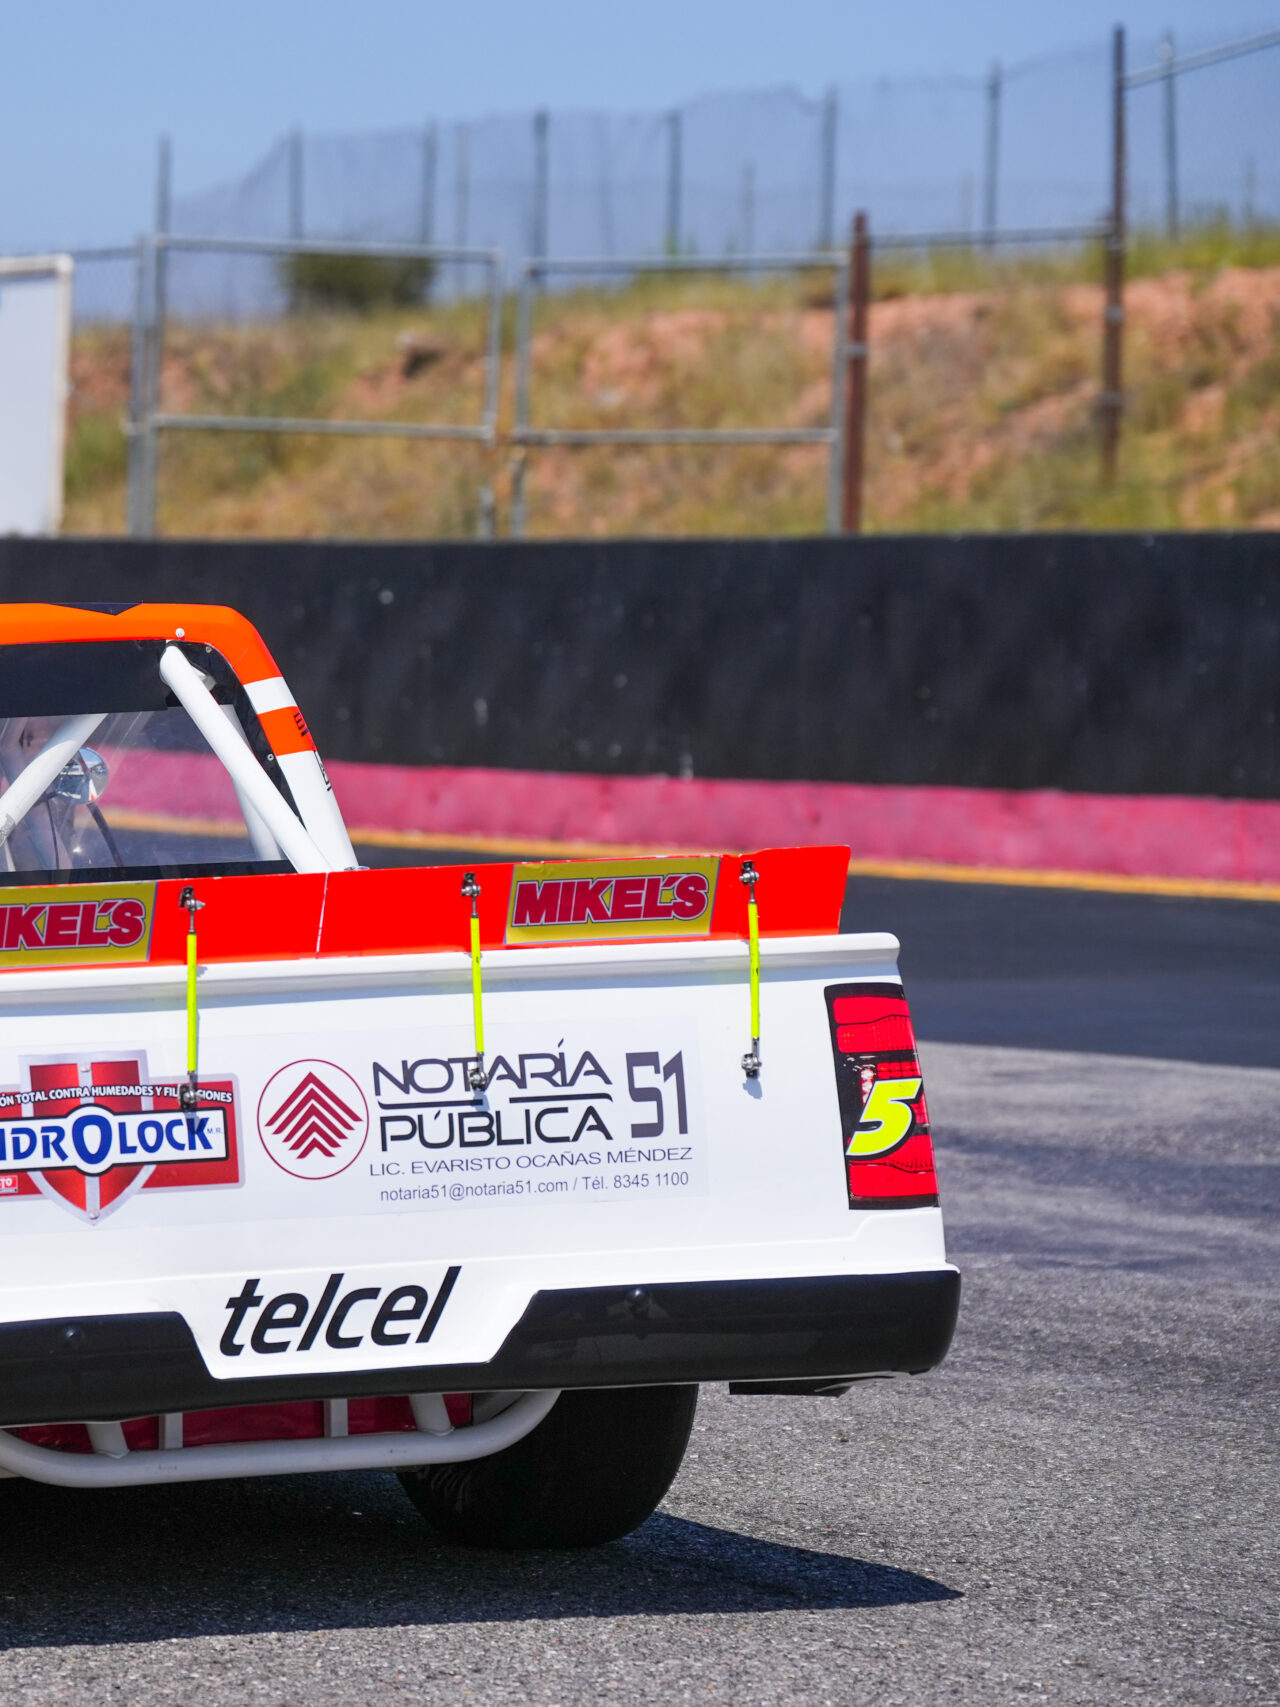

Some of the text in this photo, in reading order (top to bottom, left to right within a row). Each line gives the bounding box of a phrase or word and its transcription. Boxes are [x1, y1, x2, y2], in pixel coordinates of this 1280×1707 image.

[14, 1089, 49, 1105] TOTAL
[48, 1085, 91, 1101] CONTRA
[91, 1085, 155, 1098] HUMEDADES
[155, 1086, 163, 1096] Y
[372, 1037, 688, 1139] NOTARÍA 51
[379, 1105, 613, 1152] PÚBLICA
[844, 1077, 924, 1157] 5
[369, 1147, 693, 1176] LIC. EVARISTO OCAÑAS MÉNDEZ
[380, 1180, 568, 1201] notaria51@notaria51.com
[581, 1175, 608, 1190] Tél.
[613, 1174, 650, 1189] 8345
[654, 1171, 689, 1187] 1100
[219, 1265, 462, 1357] telcel
